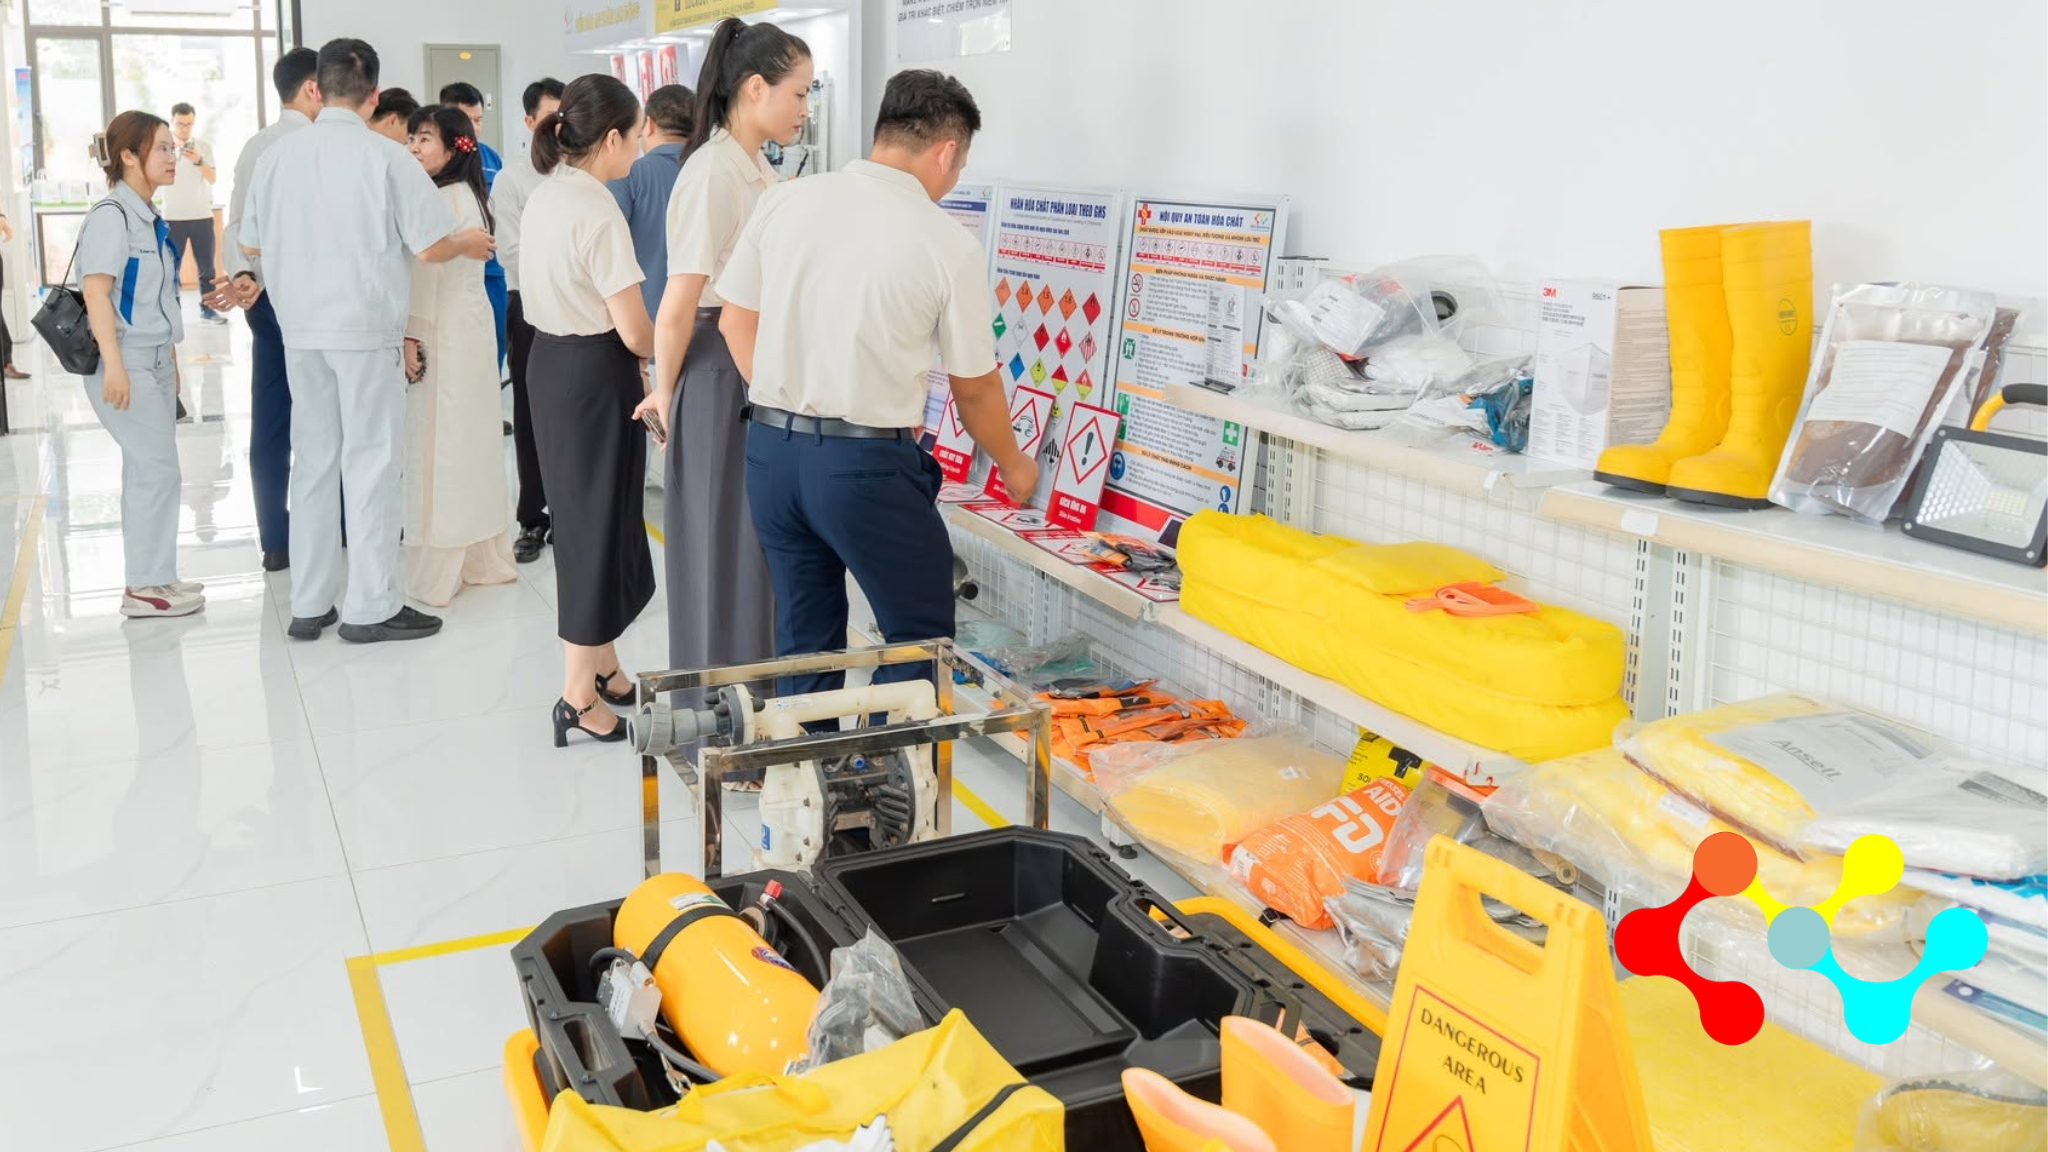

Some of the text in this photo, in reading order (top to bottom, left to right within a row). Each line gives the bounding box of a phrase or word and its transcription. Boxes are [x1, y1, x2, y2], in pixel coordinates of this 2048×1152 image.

[1036, 198, 1050, 213] CHẤT
[1078, 204, 1093, 217] THEO
[1094, 205, 1107, 219] GHS
[1171, 212, 1182, 223] QUY
[1183, 213, 1192, 223] AN
[1226, 214, 1244, 228] CHẤT
[1542, 287, 1557, 297] 3M
[1769, 739, 1842, 778] Ansell
[1362, 785, 1402, 816] AID
[1420, 1008, 1524, 1083] DANGEROUS
[1443, 1055, 1487, 1095] AREA
